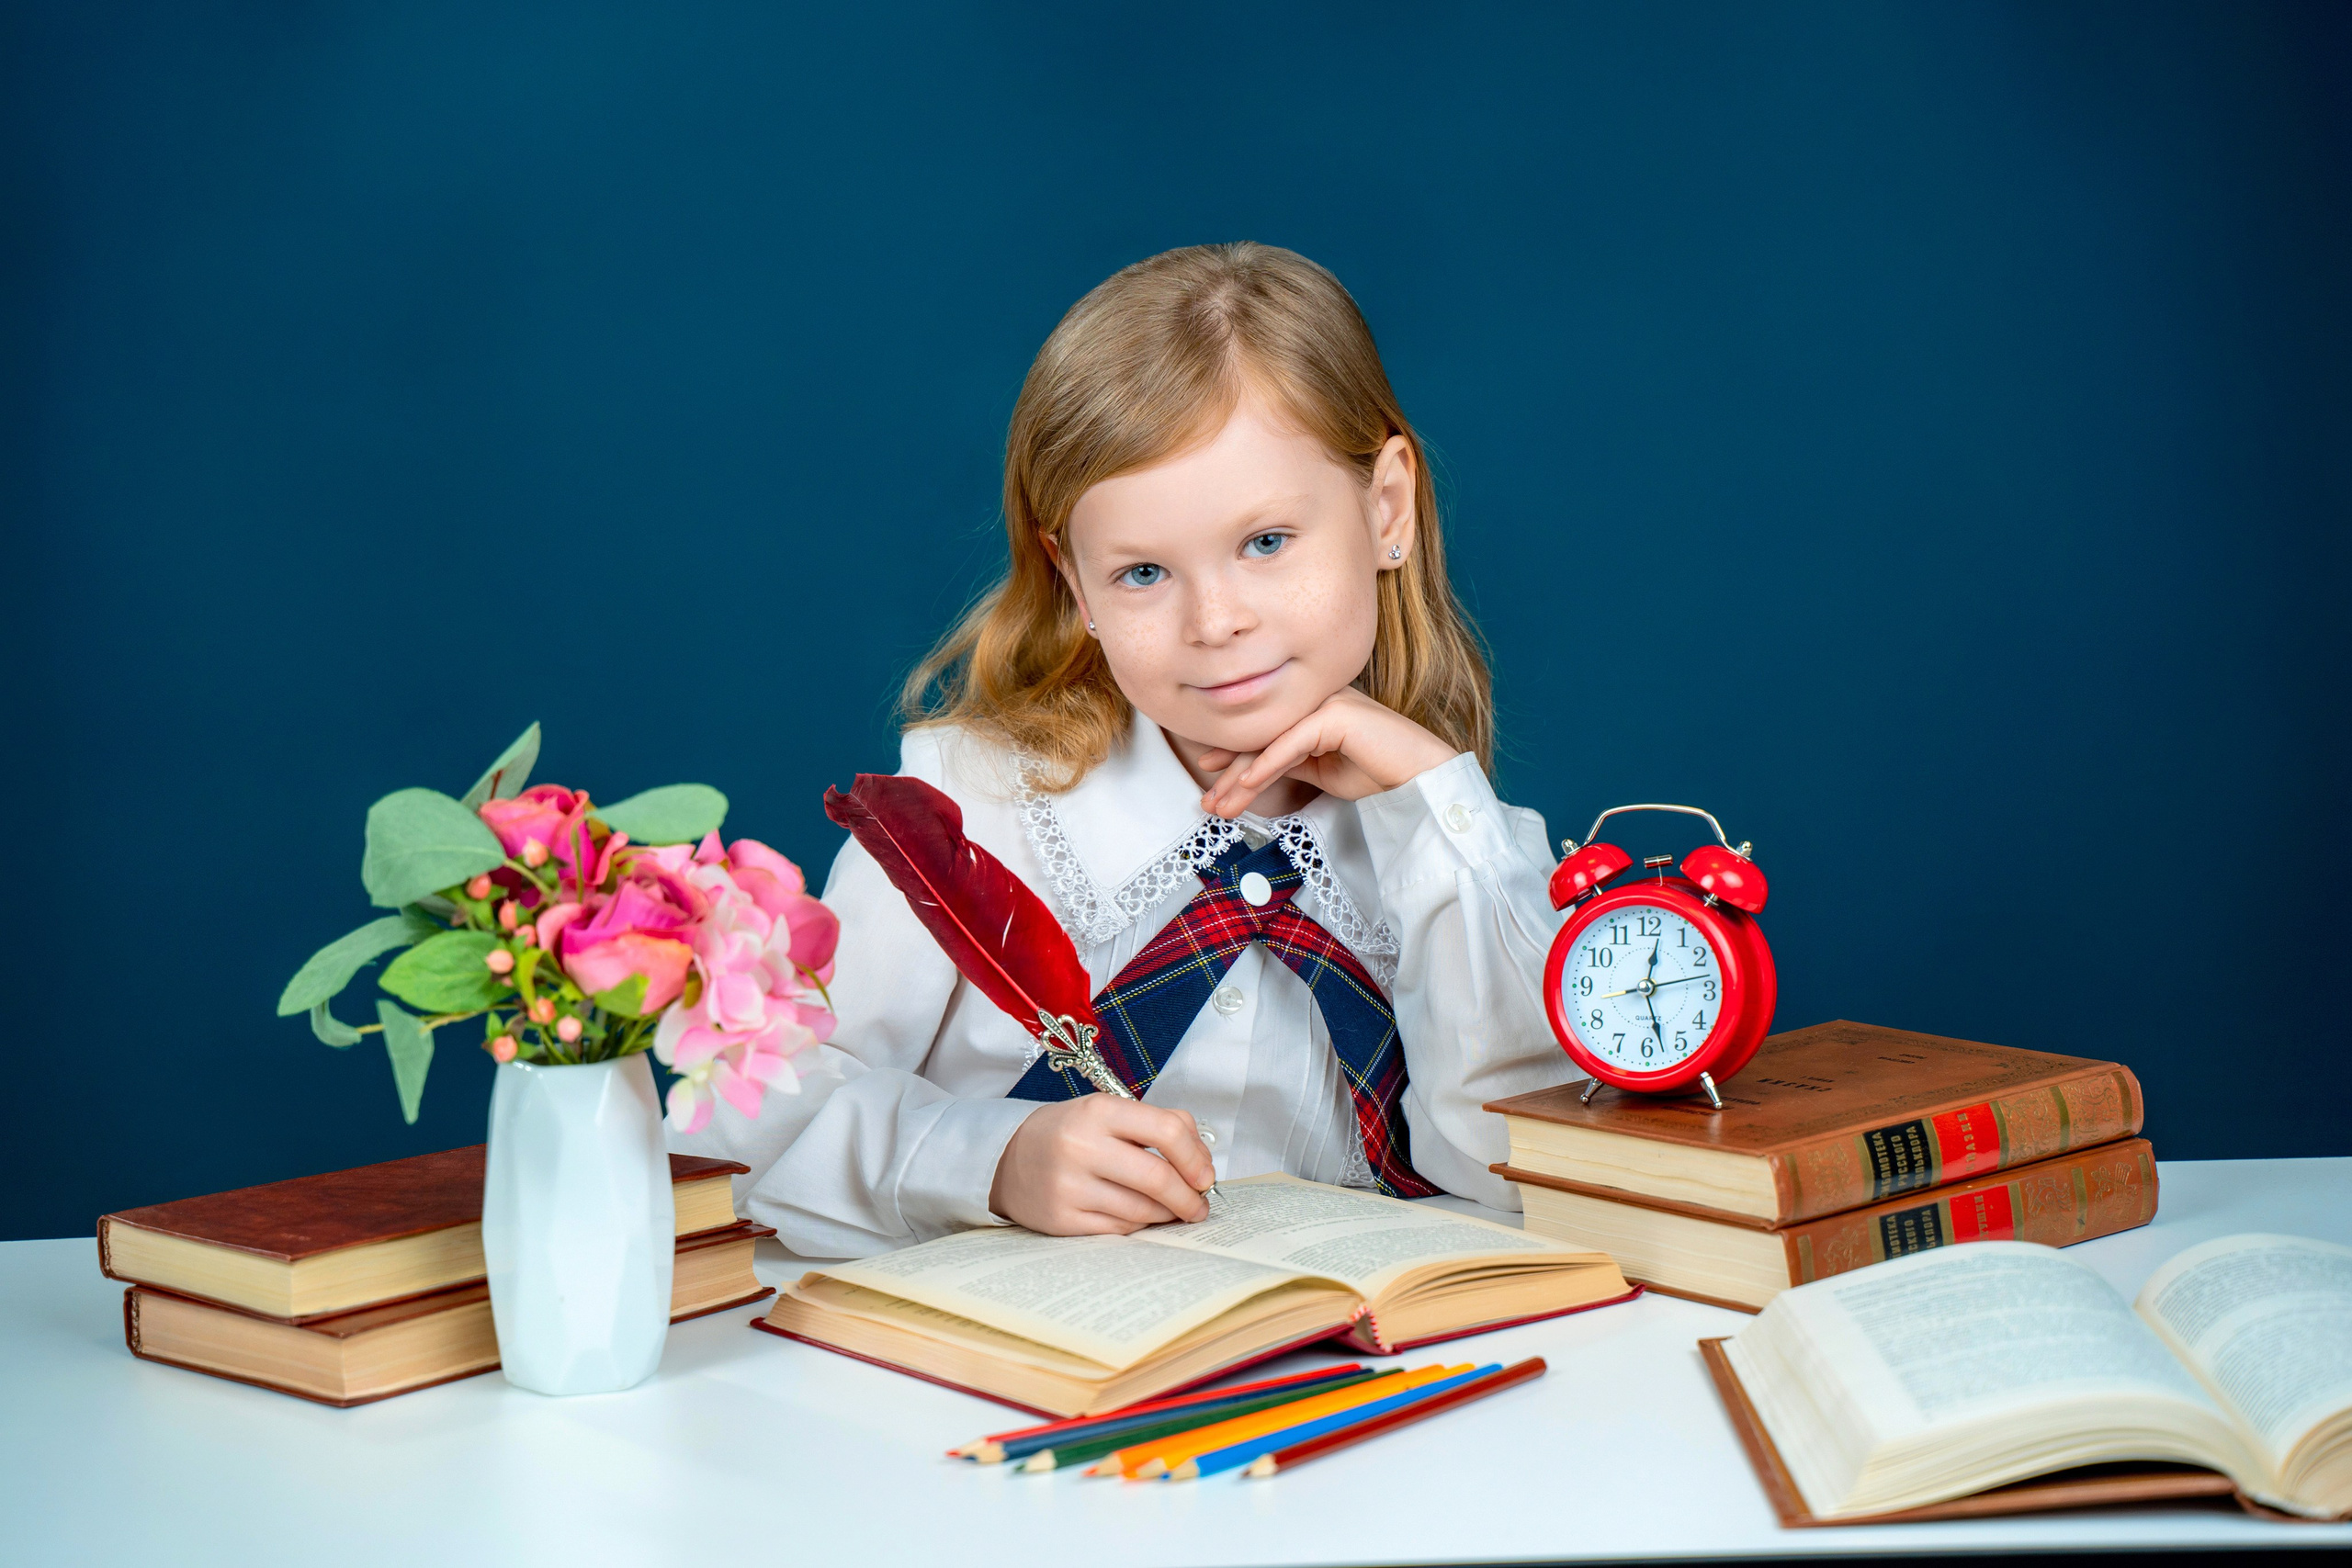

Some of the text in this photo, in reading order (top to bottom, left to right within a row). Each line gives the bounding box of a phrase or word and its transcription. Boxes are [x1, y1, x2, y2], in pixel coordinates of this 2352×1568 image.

[1609, 925, 1631, 945] 11
[1636, 916, 1662, 936] 12
[1677, 928, 1689, 947] 1
[1588, 947, 1612, 967] 10
[1693, 947, 1706, 966] 2
[1580, 976, 1593, 996] 9
[1703, 980, 1716, 1000] 3
[1590, 1010, 1603, 1030] 8
[1692, 1010, 1707, 1030] 4
[1612, 1032, 1625, 1053] 7
[1641, 1037, 1654, 1057] 6
[1674, 1031, 1688, 1051] 5
[1957, 1112, 1976, 1171] СКАЗКИ
[1891, 1134, 1908, 1187] РУССКОГО
